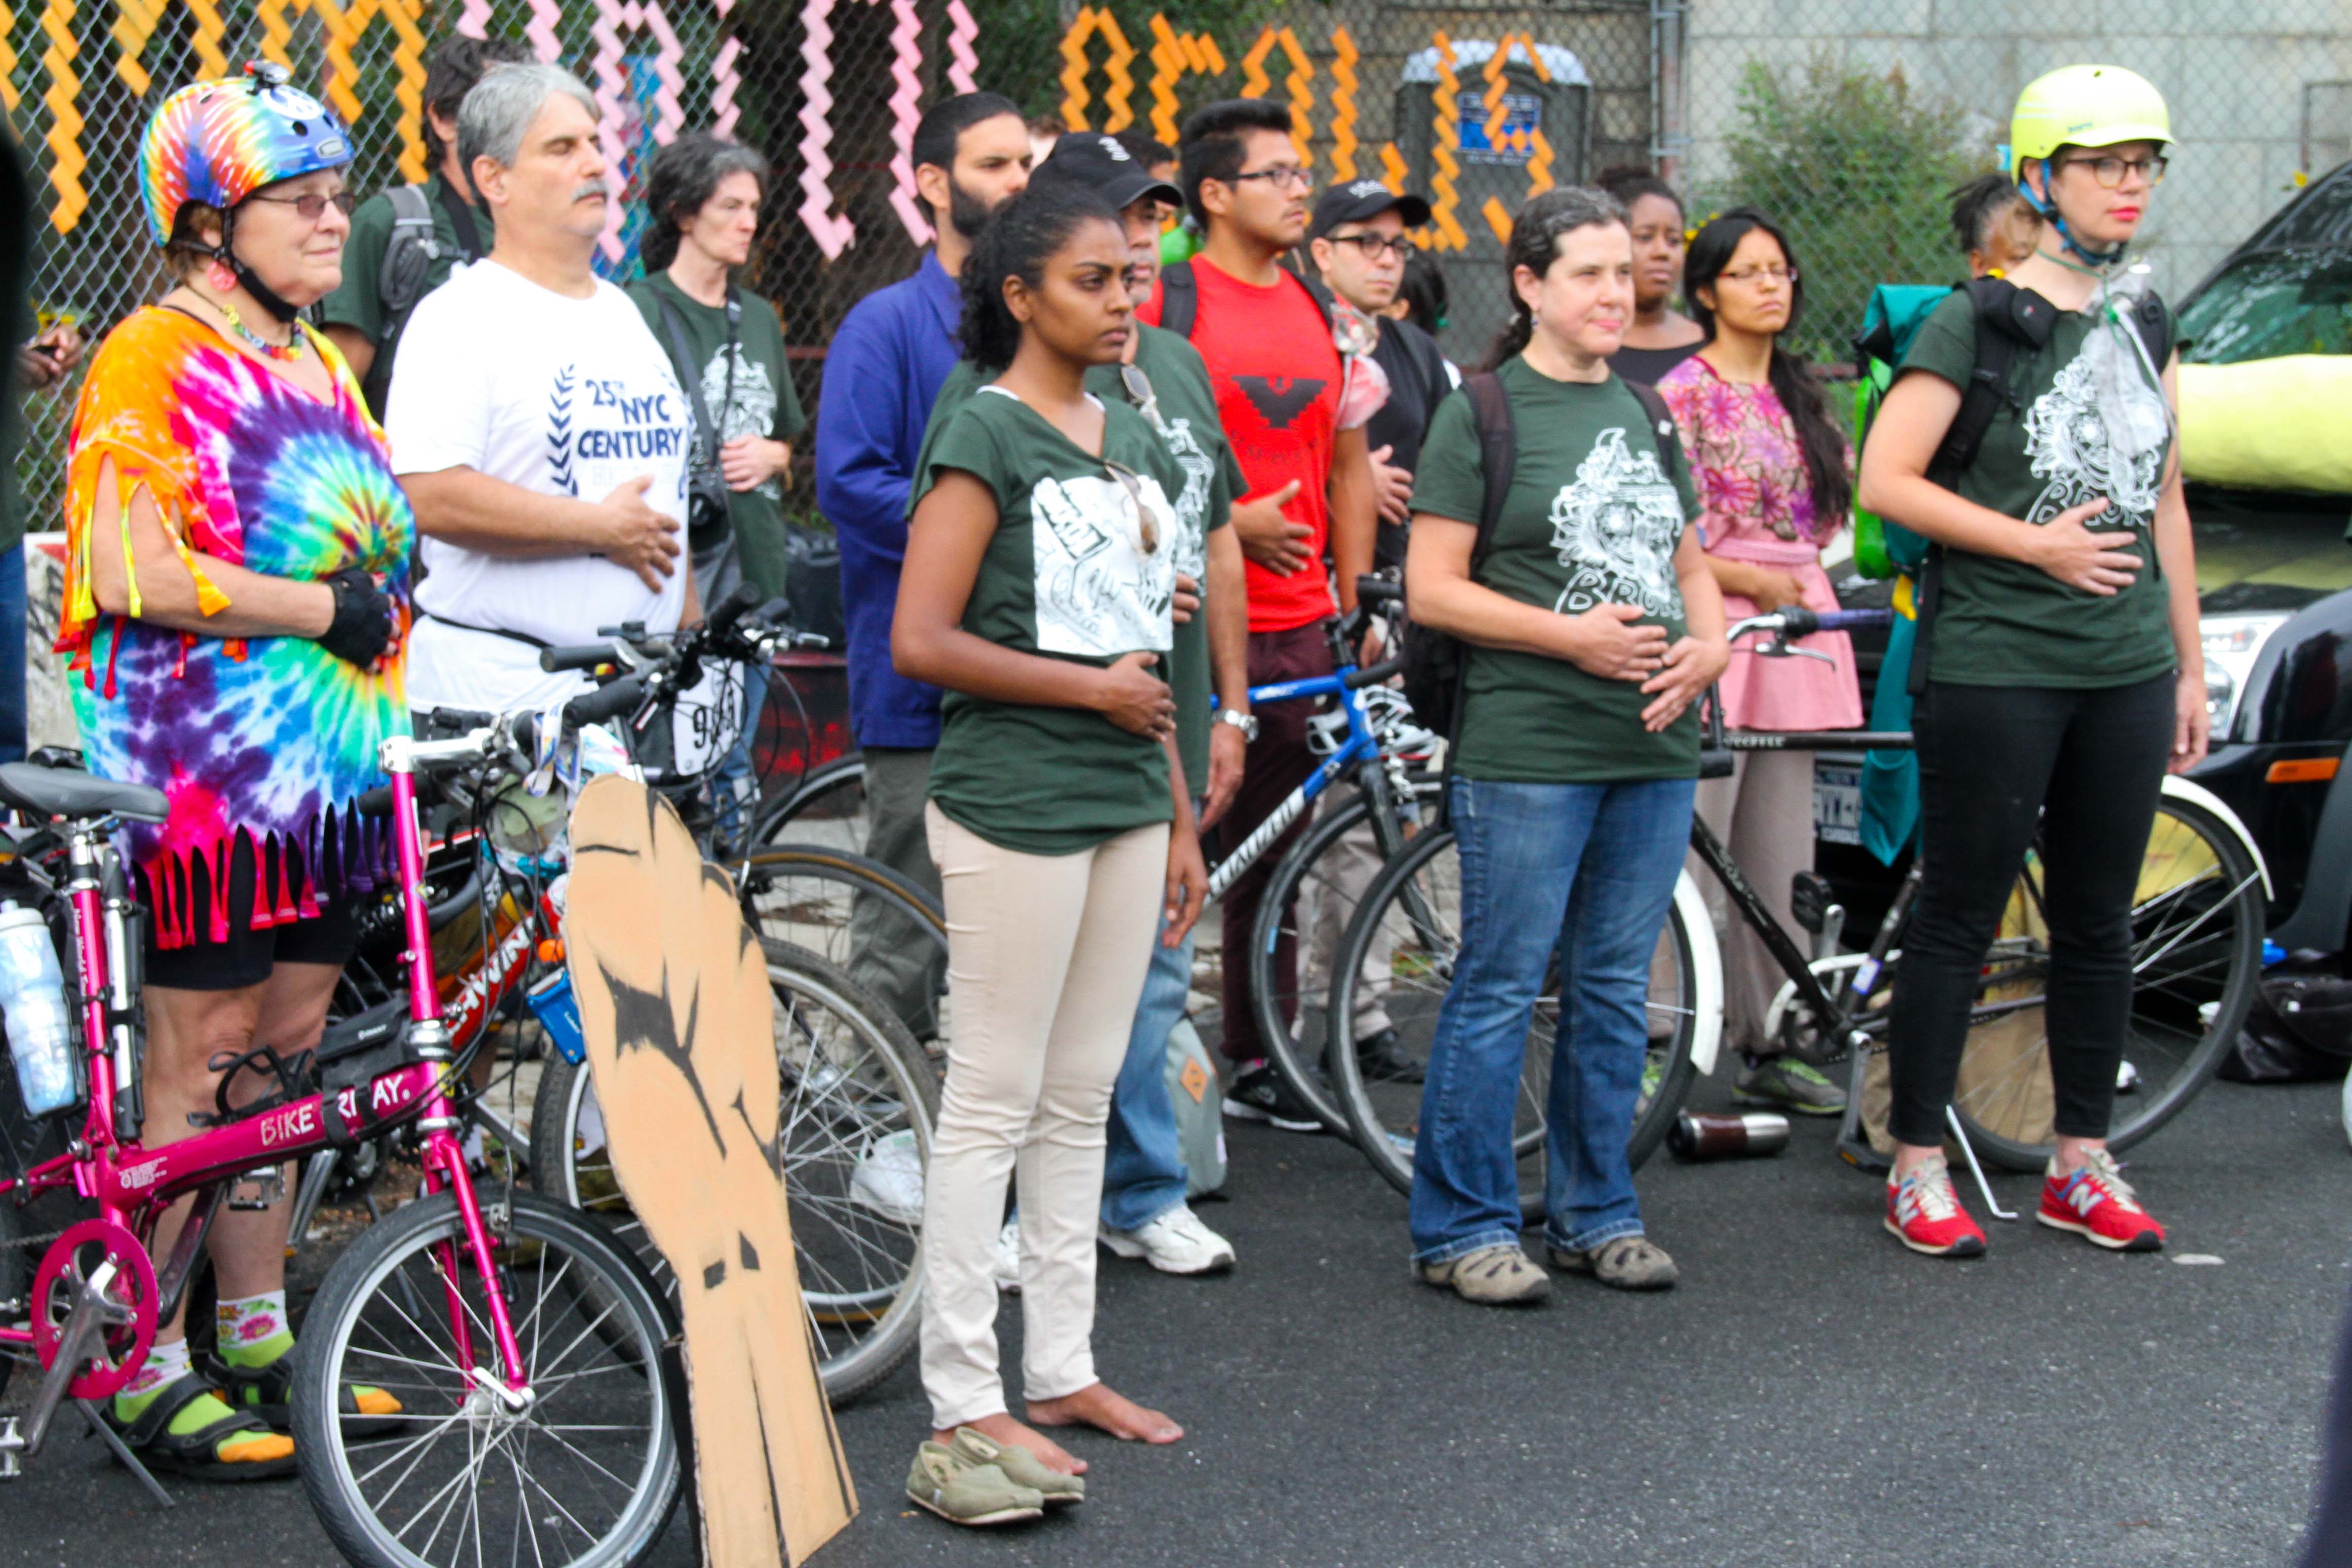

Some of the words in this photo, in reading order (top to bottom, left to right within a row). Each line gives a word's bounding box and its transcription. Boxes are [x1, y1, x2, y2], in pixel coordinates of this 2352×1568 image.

[620, 394, 671, 425] NYC
[578, 428, 683, 459] CENTURY
[260, 1103, 315, 1146] BIKE
[336, 1073, 411, 1119] RIAY.
